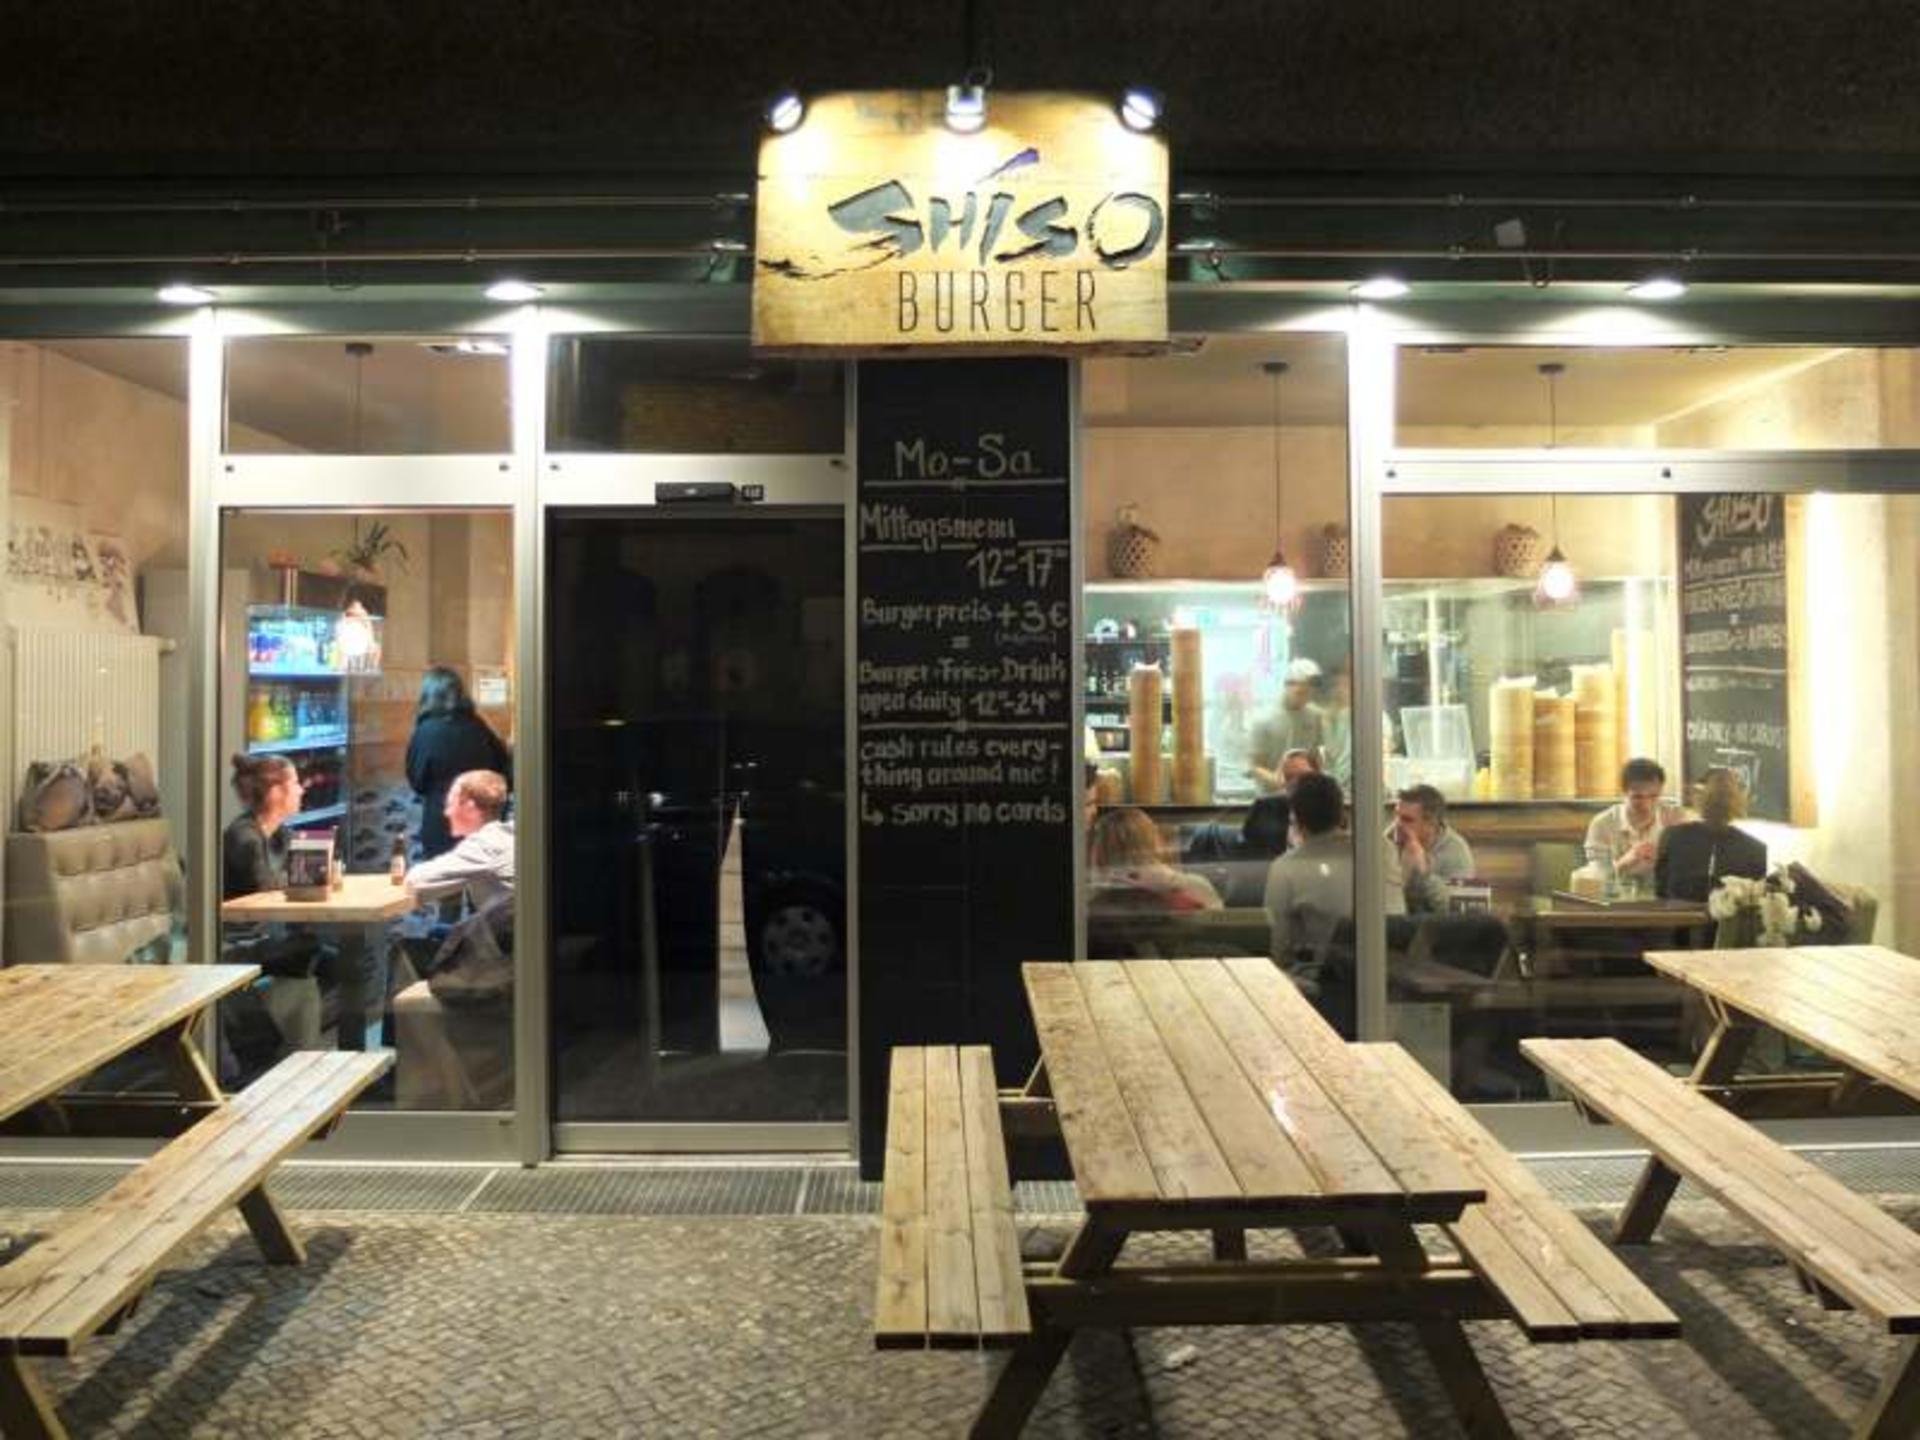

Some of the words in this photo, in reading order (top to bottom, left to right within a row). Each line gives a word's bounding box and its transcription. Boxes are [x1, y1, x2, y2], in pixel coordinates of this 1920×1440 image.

[898, 269, 1098, 333] BURGER
[921, 733, 979, 759] rules
[861, 762, 923, 791] thing
[928, 761, 1004, 785] around
[963, 802, 991, 824] no
[996, 796, 1067, 823] cards
